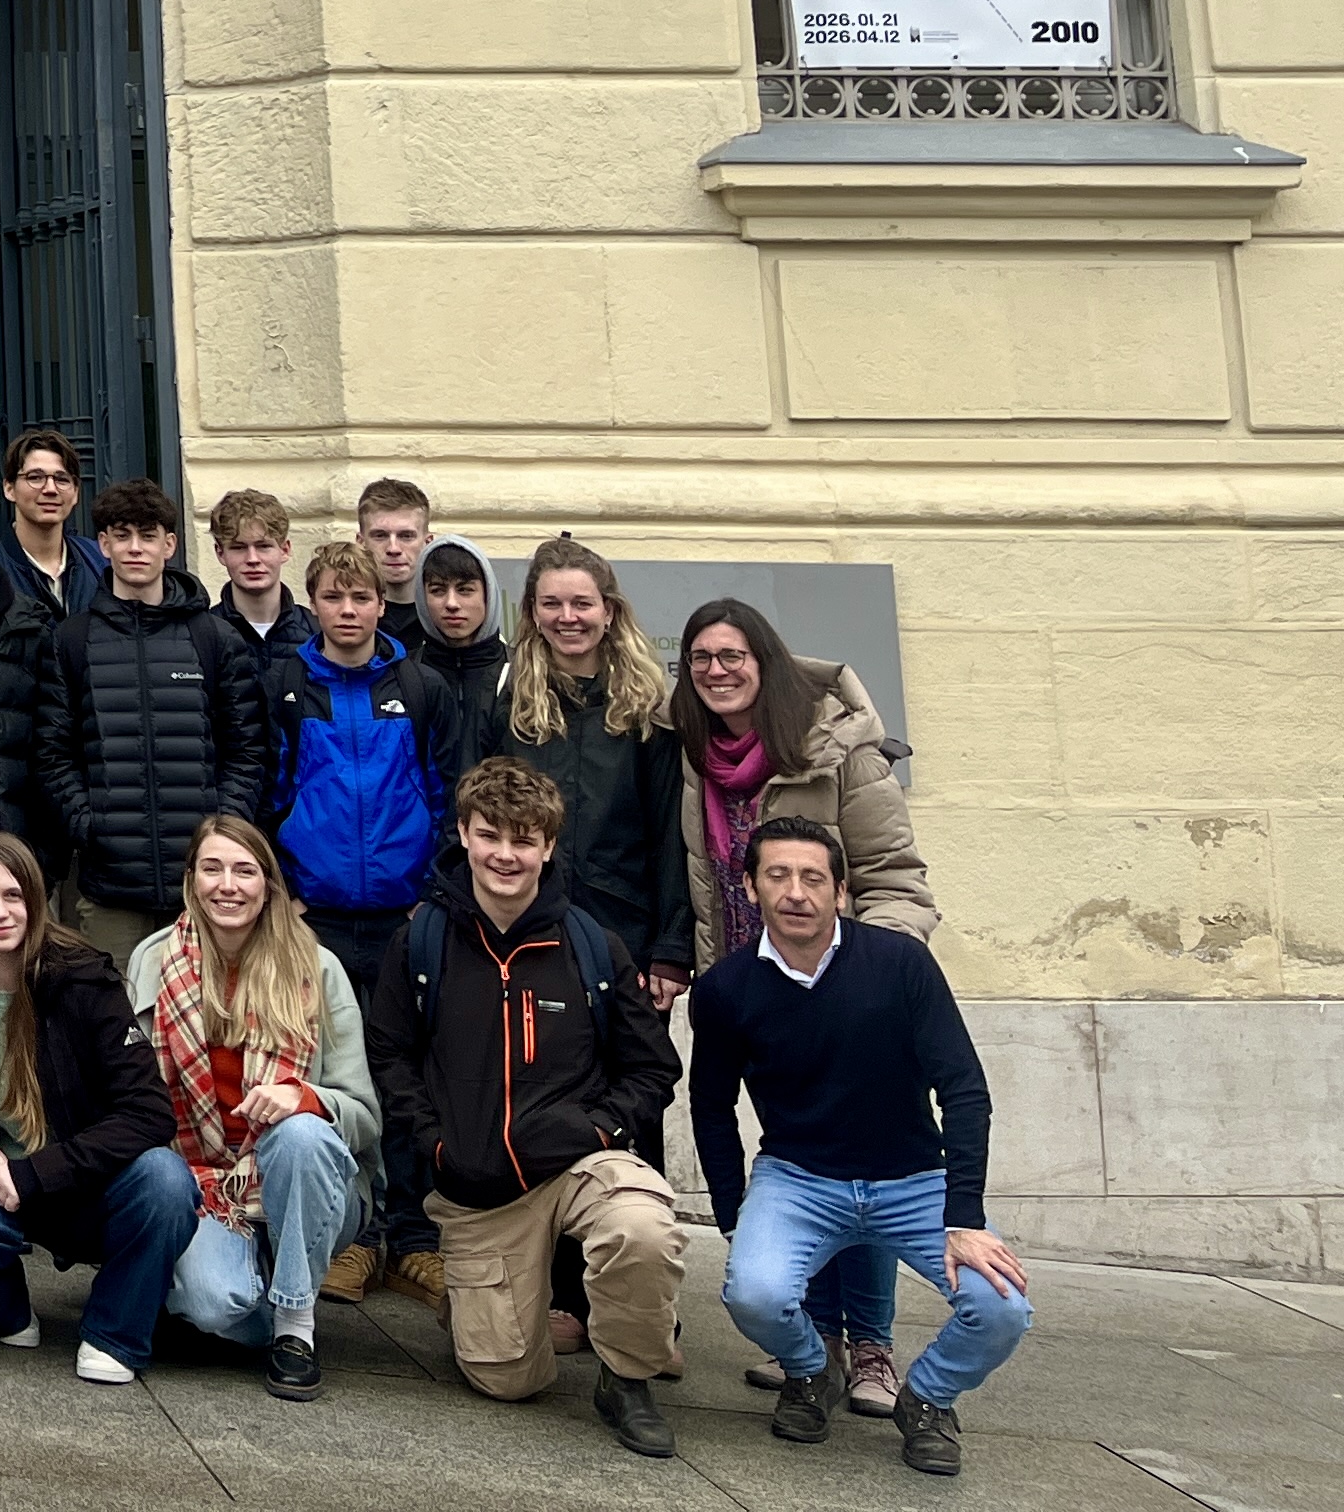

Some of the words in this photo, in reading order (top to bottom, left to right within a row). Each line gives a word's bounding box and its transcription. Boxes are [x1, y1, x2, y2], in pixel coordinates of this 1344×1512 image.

[804, 13, 898, 27] 2026.01.21
[804, 30, 901, 44] 2026.04.12
[1031, 20, 1099, 44] 2010
